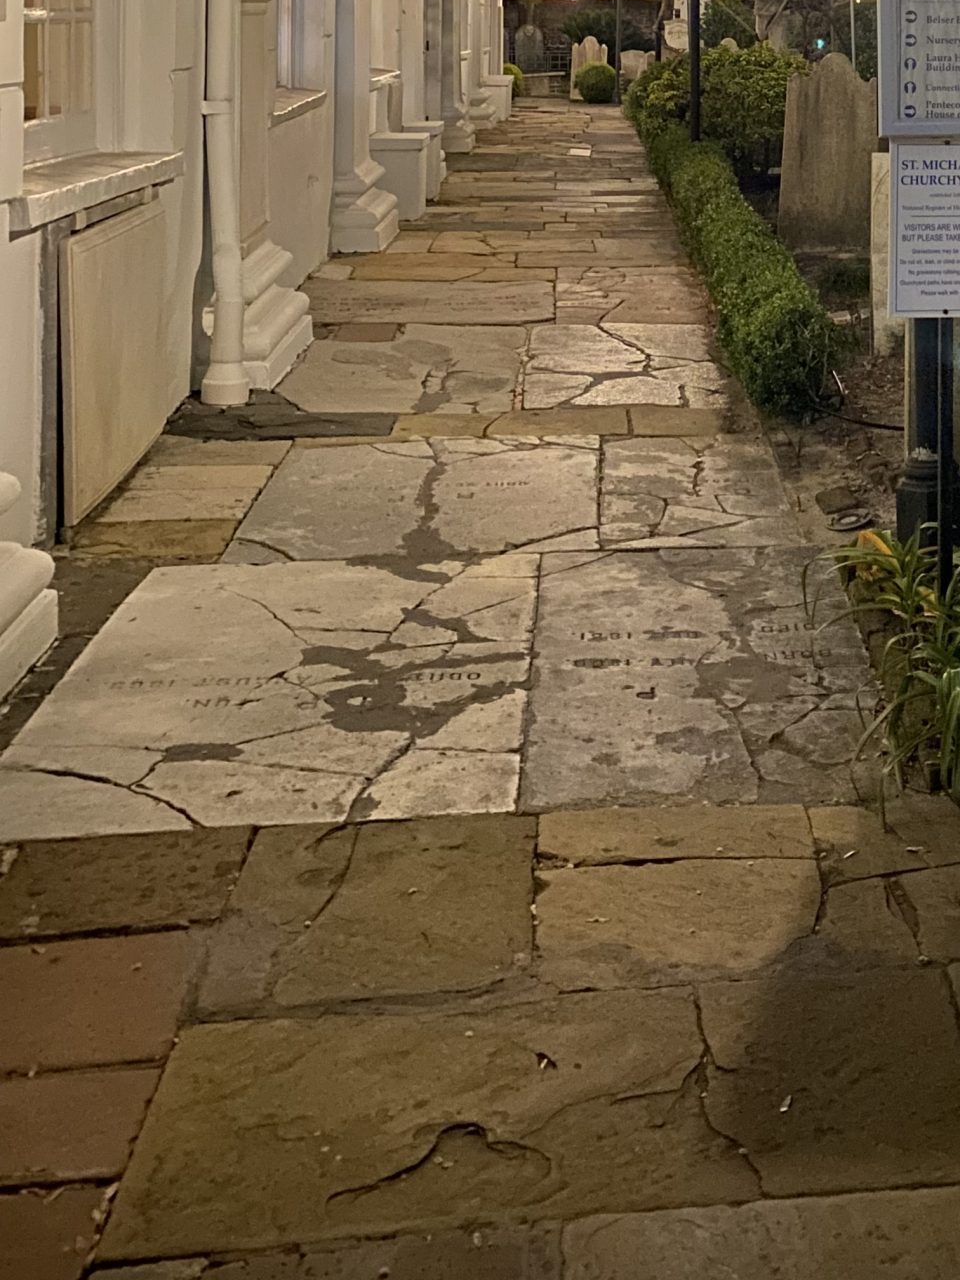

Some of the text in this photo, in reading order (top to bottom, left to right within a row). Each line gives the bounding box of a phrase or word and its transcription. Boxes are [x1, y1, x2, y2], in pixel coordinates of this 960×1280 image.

[925, 53, 952, 62] Laura
[925, 110, 956, 119] House
[901, 159, 919, 170] ST.
[904, 223, 935, 232] VISITORS
[937, 223, 951, 232] ARE
[902, 233, 915, 242] BUT
[917, 233, 943, 242] PLEASE
[763, 649, 832, 661] BORN
